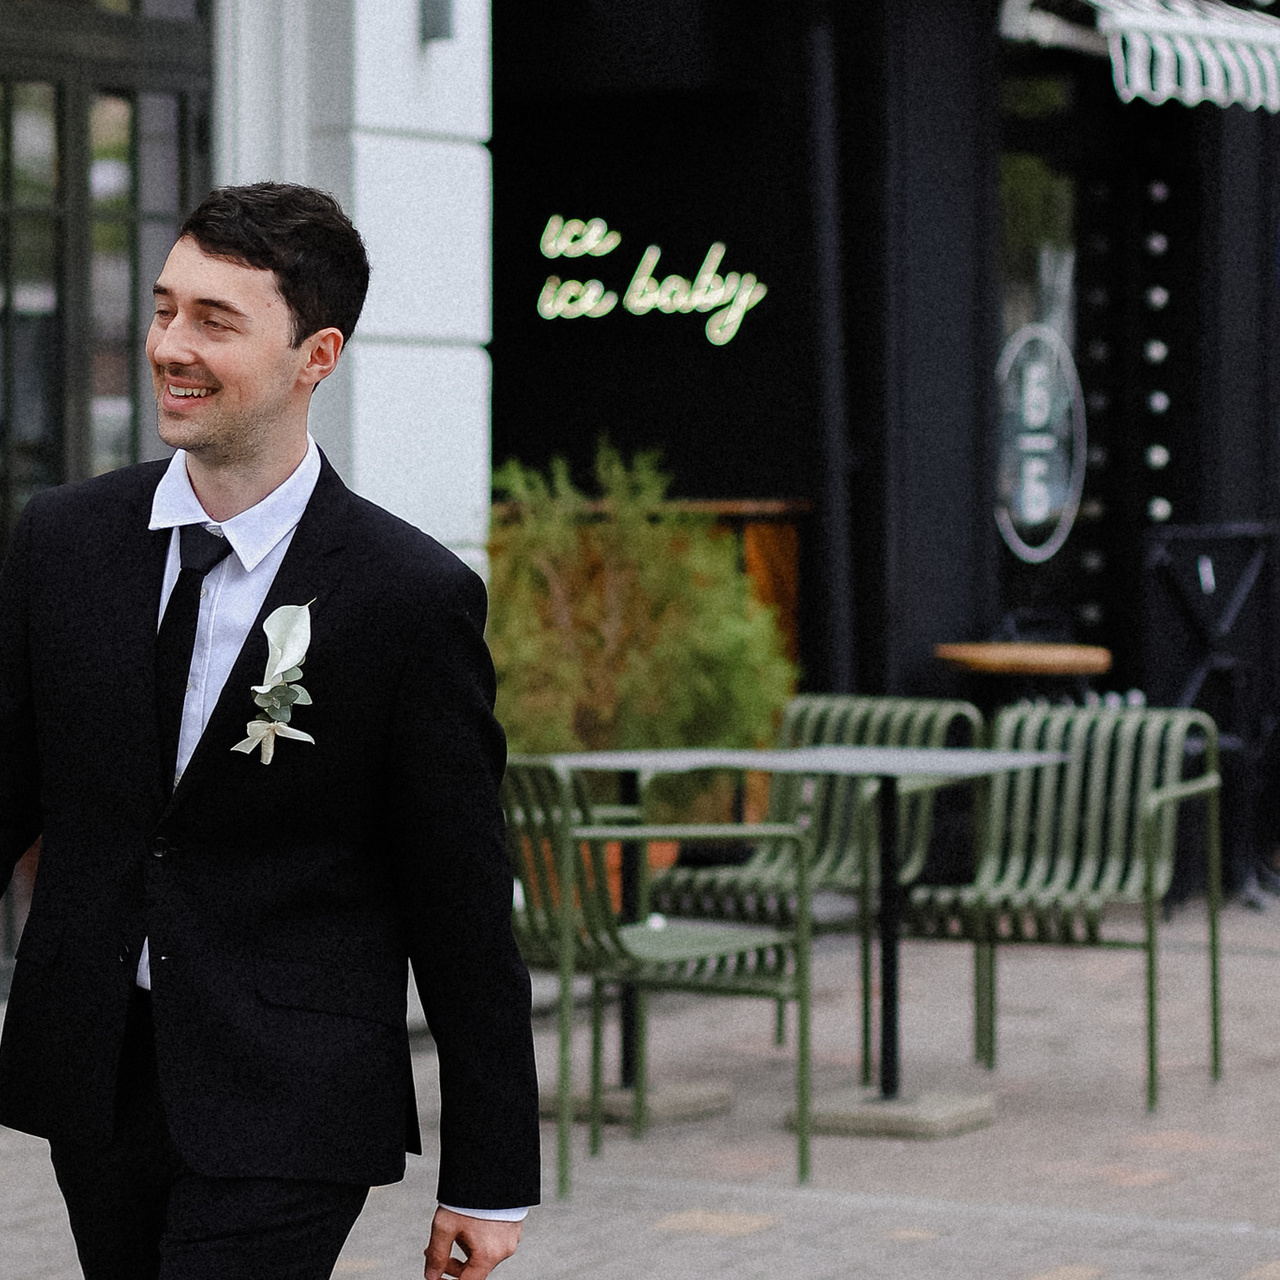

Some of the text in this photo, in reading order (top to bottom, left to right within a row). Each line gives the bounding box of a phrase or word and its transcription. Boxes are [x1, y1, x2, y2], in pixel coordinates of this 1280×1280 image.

[540, 214, 621, 259] ice
[537, 242, 768, 346] ice baby
